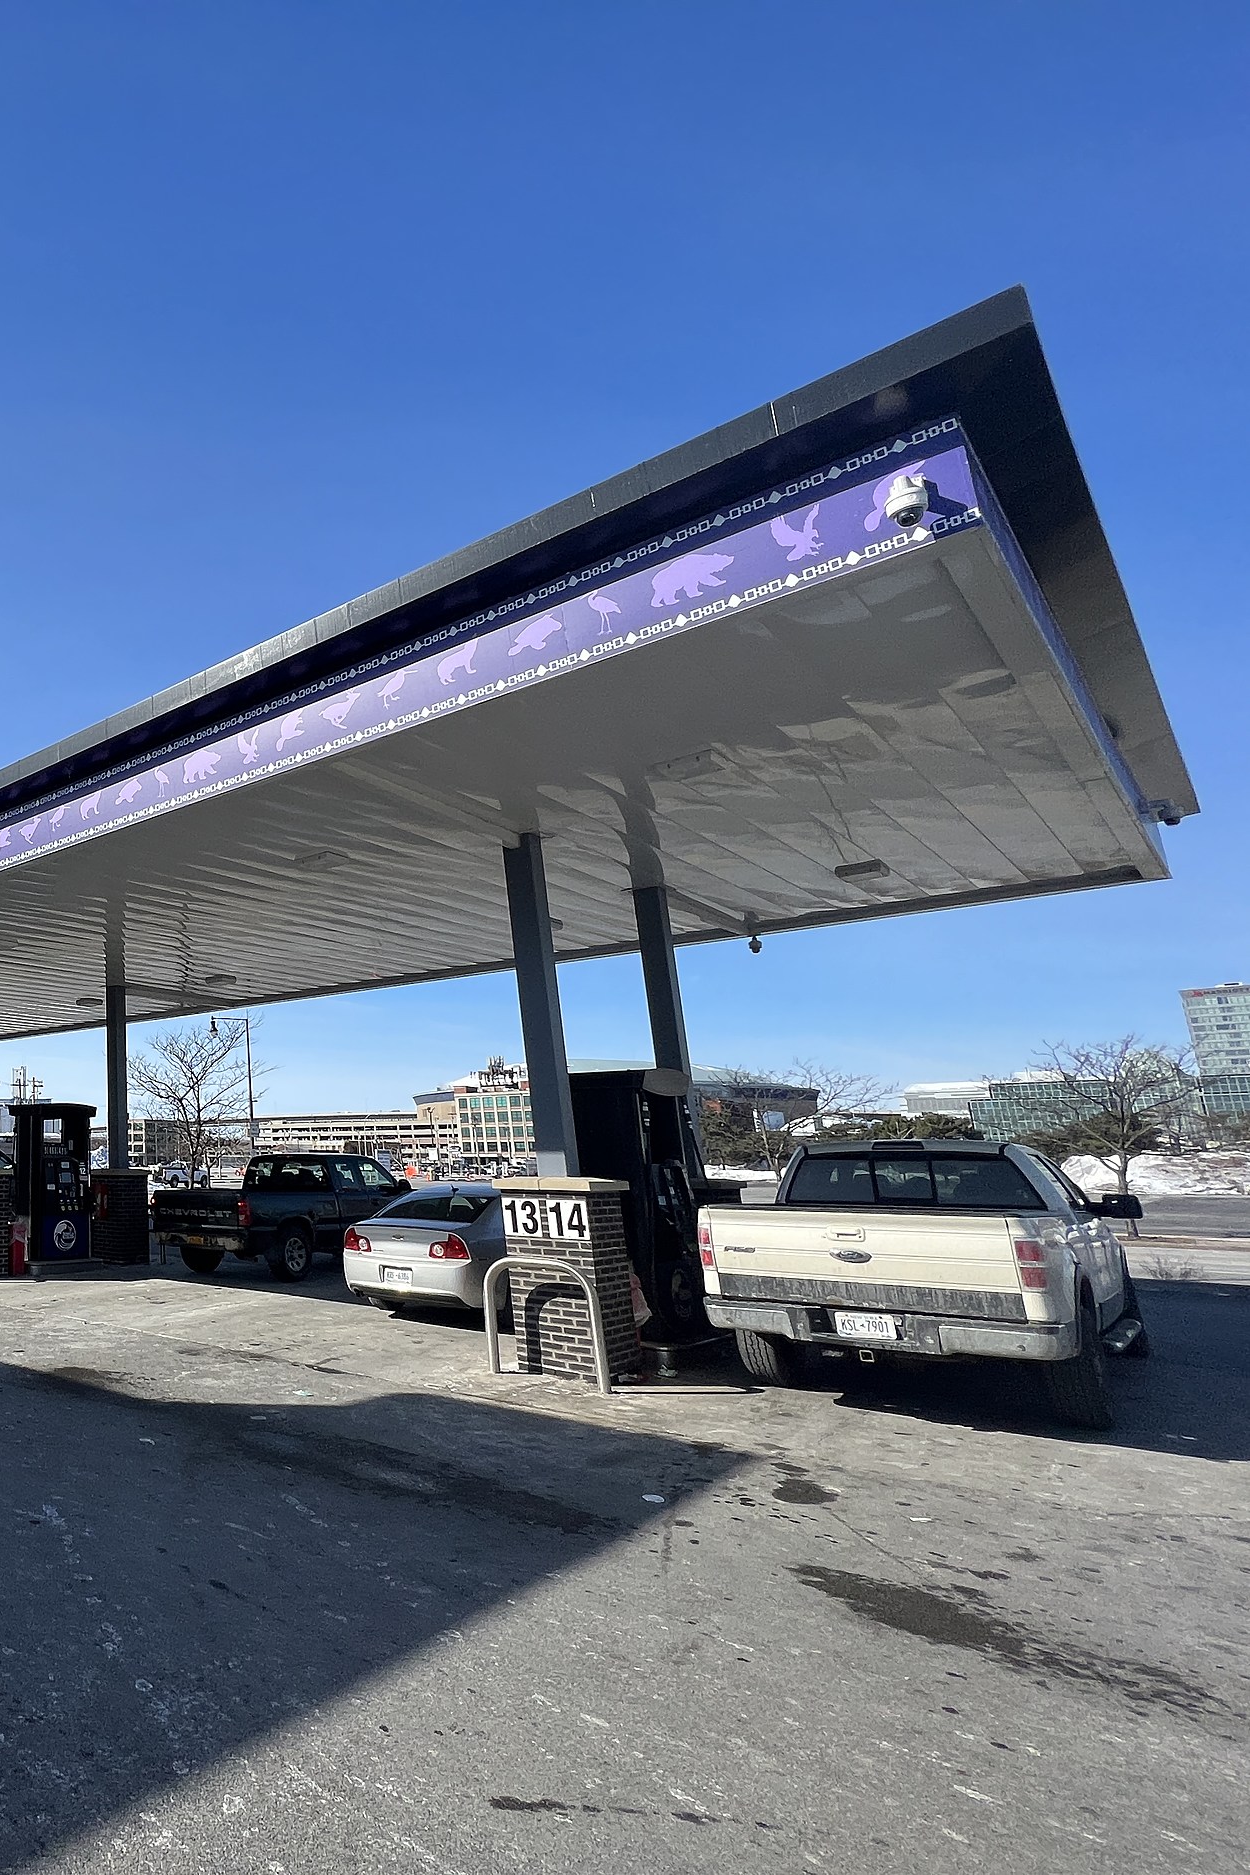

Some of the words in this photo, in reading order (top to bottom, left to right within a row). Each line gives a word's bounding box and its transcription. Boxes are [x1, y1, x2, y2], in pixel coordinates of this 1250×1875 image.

[160, 1207, 232, 1218] CHEVROLET
[504, 1200, 540, 1235] 13
[549, 1202, 587, 1237] 14
